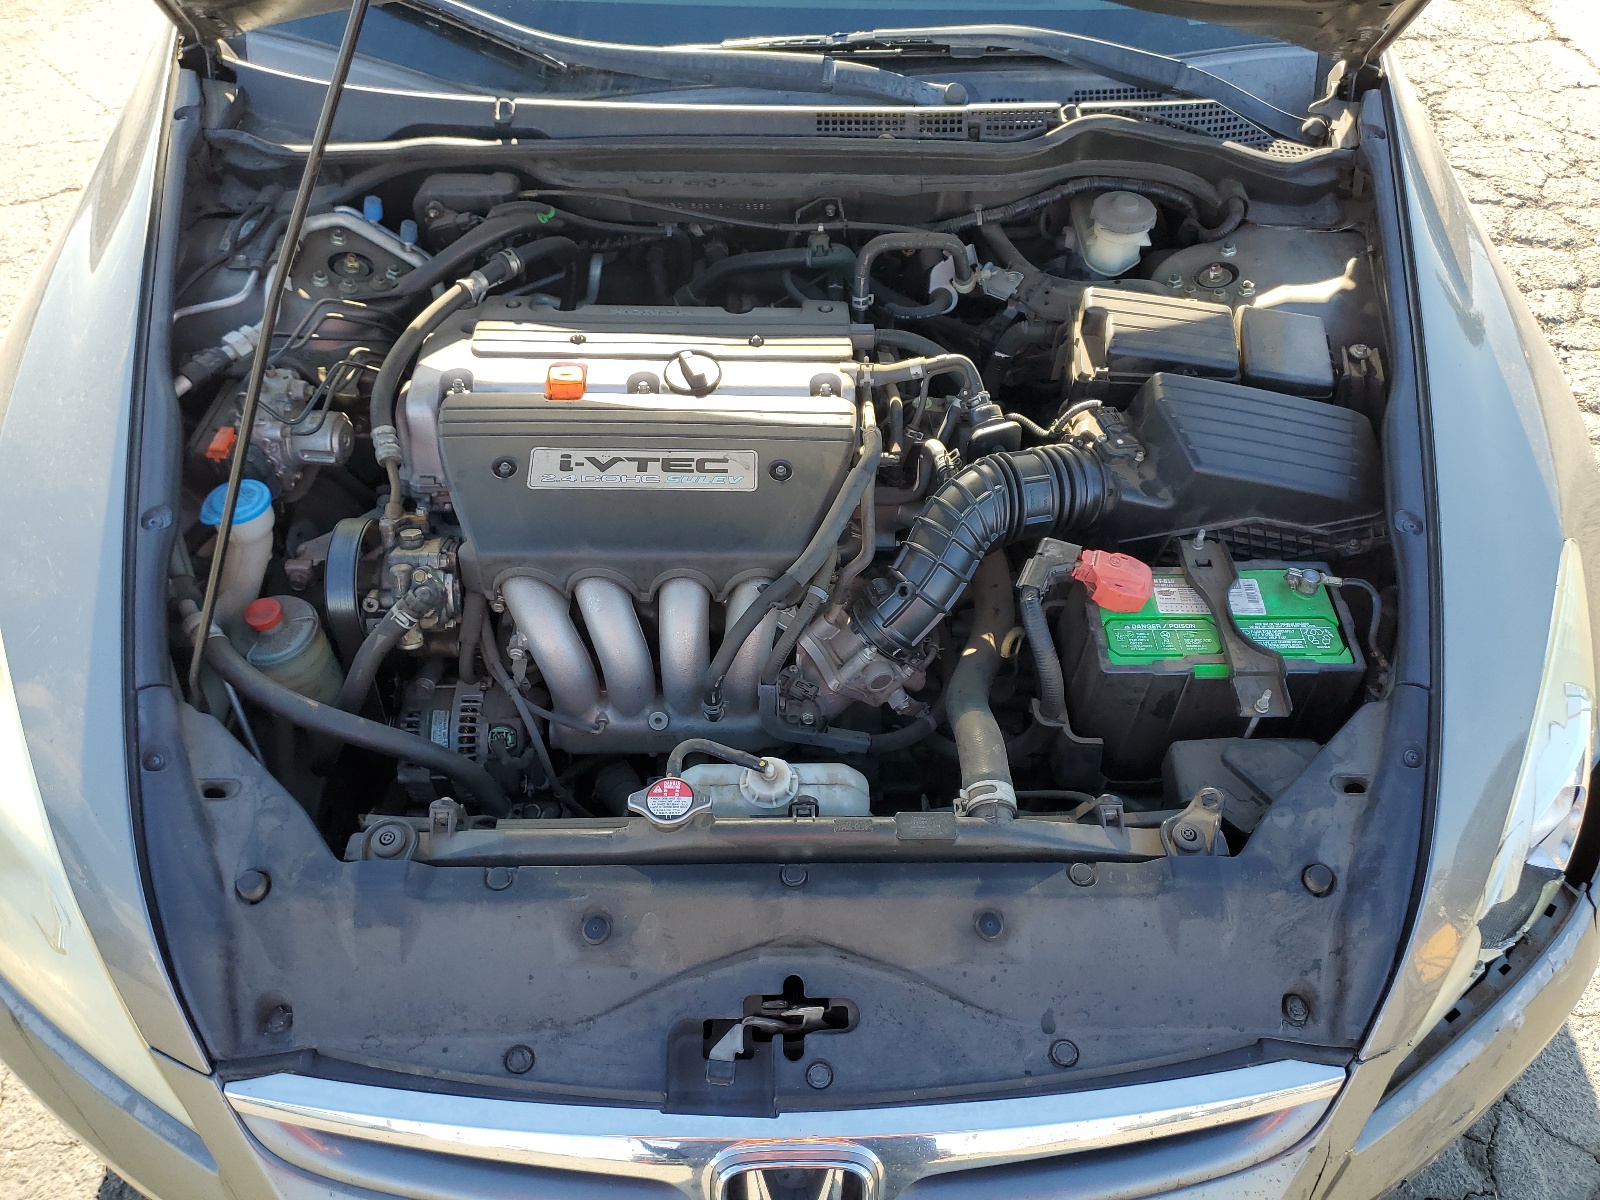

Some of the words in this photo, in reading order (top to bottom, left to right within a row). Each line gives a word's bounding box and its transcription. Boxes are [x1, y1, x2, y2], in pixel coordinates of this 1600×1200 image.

[559, 453, 730, 474] i-VTEC
[540, 473, 578, 483] 2.4
[581, 474, 661, 484] DOHC
[664, 475, 745, 485] SULEV
